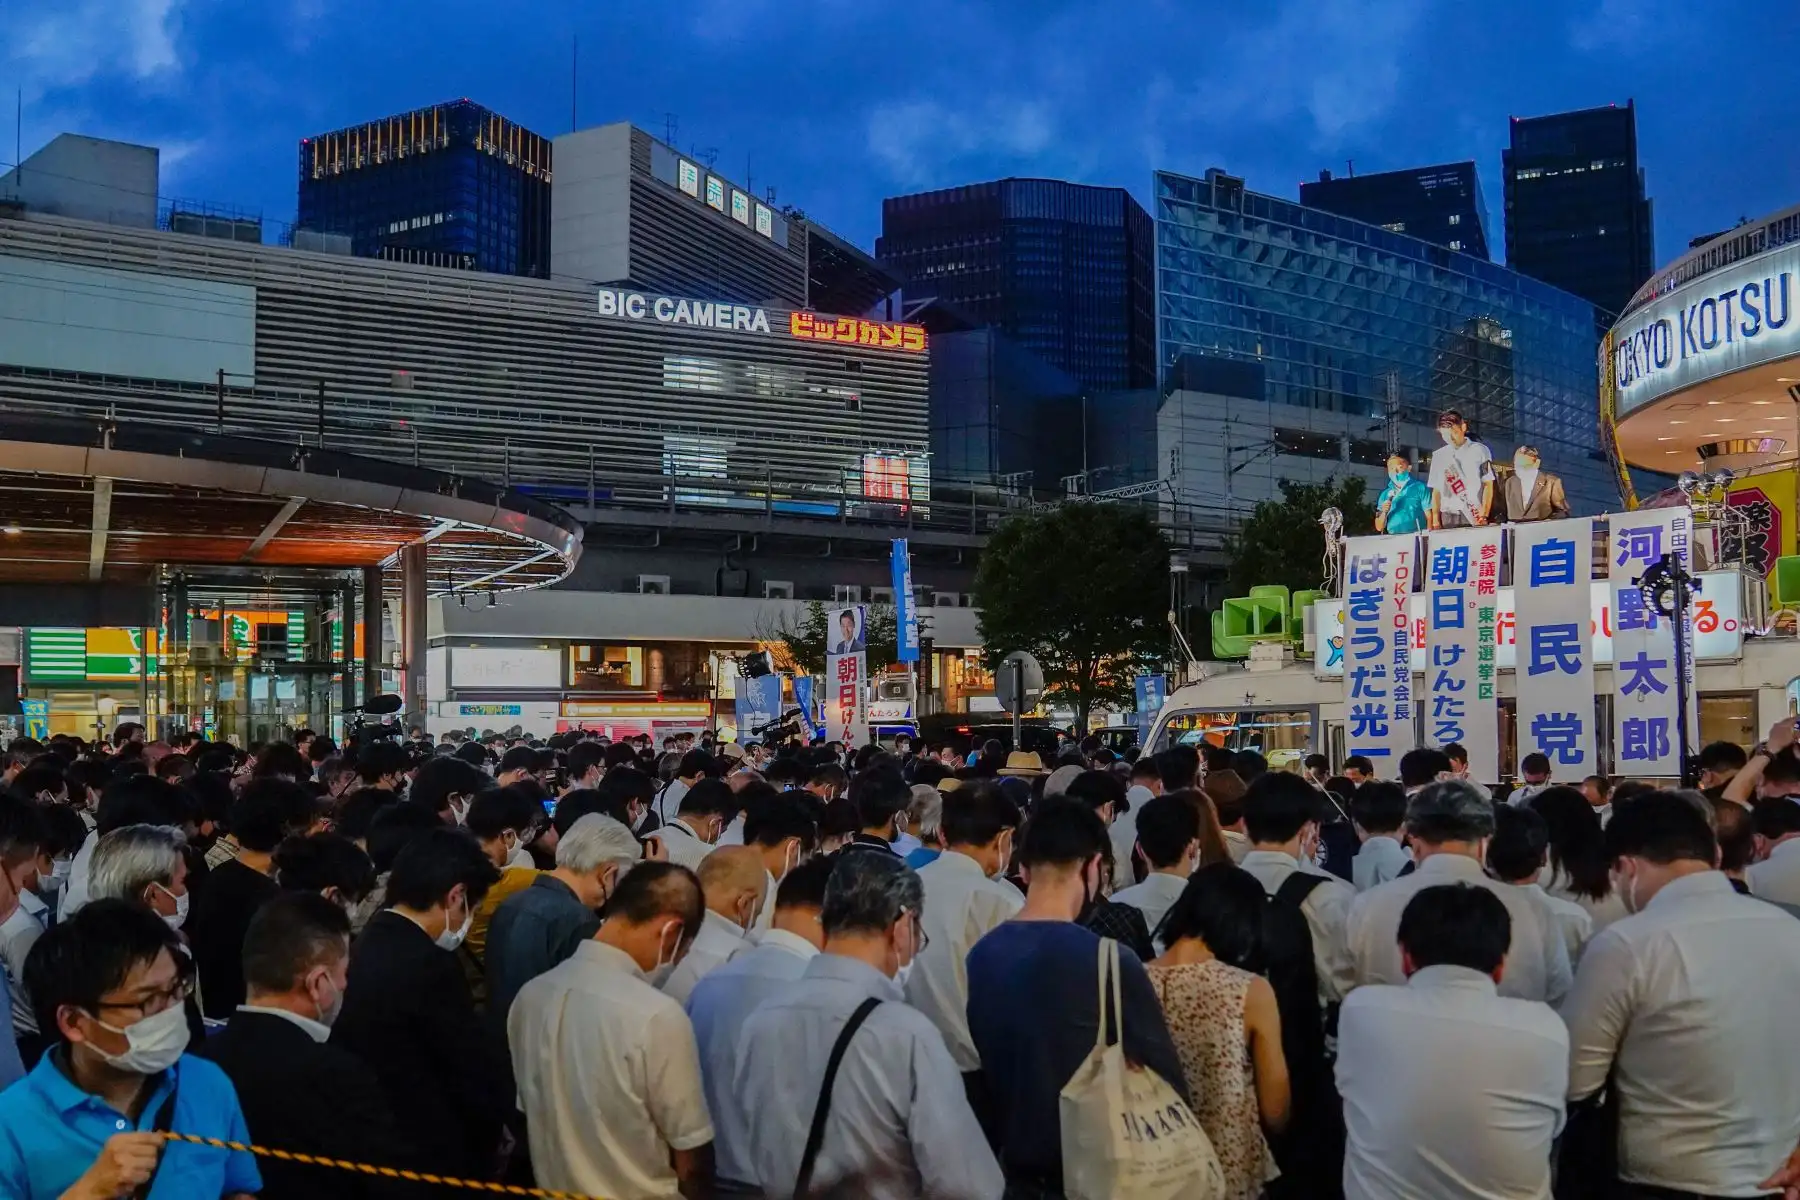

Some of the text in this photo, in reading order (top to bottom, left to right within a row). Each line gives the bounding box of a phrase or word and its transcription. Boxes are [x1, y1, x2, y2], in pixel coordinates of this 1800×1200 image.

[598, 289, 770, 333] BIC CAMERA
[790, 312, 926, 351] ビックカメラ
[1616, 319, 1672, 388] OKYO
[1680, 273, 1792, 359] KOTSU
[1348, 555, 1391, 757] はぎうだ光一
[1431, 546, 1469, 744] 朝日 けんたろ
[1478, 544, 1497, 700] 参議院 東京選挙区
[1528, 537, 1584, 765] 自民党
